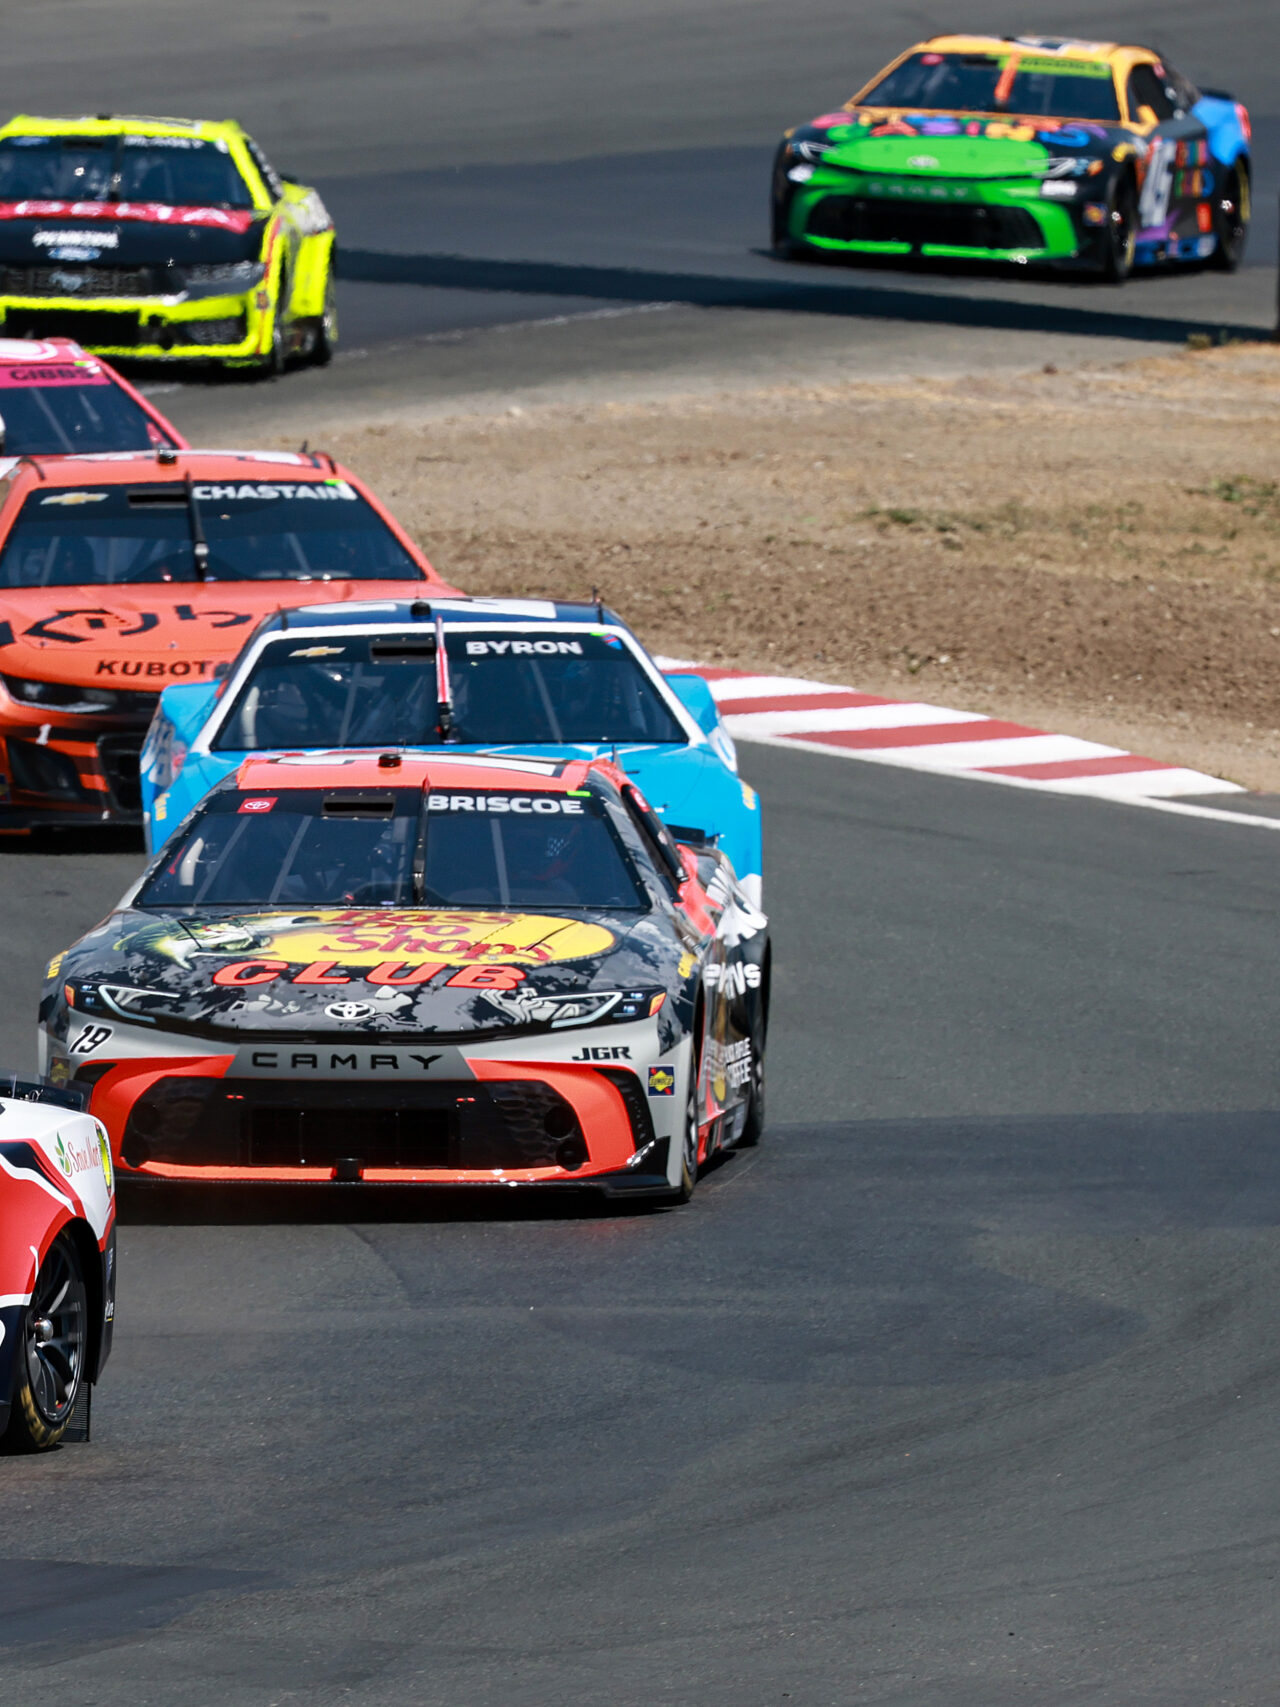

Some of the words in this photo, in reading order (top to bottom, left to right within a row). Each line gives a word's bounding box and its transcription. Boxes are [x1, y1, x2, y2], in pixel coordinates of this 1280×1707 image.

[466, 640, 583, 655] BYRON
[96, 659, 214, 676] KUBOT
[36, 723, 52, 745] 1
[428, 794, 585, 814] BRISCOE
[213, 960, 527, 990] CLUB
[69, 1023, 113, 1055] 19
[252, 1051, 444, 1070] CAMRY
[571, 1046, 633, 1061] JGR
